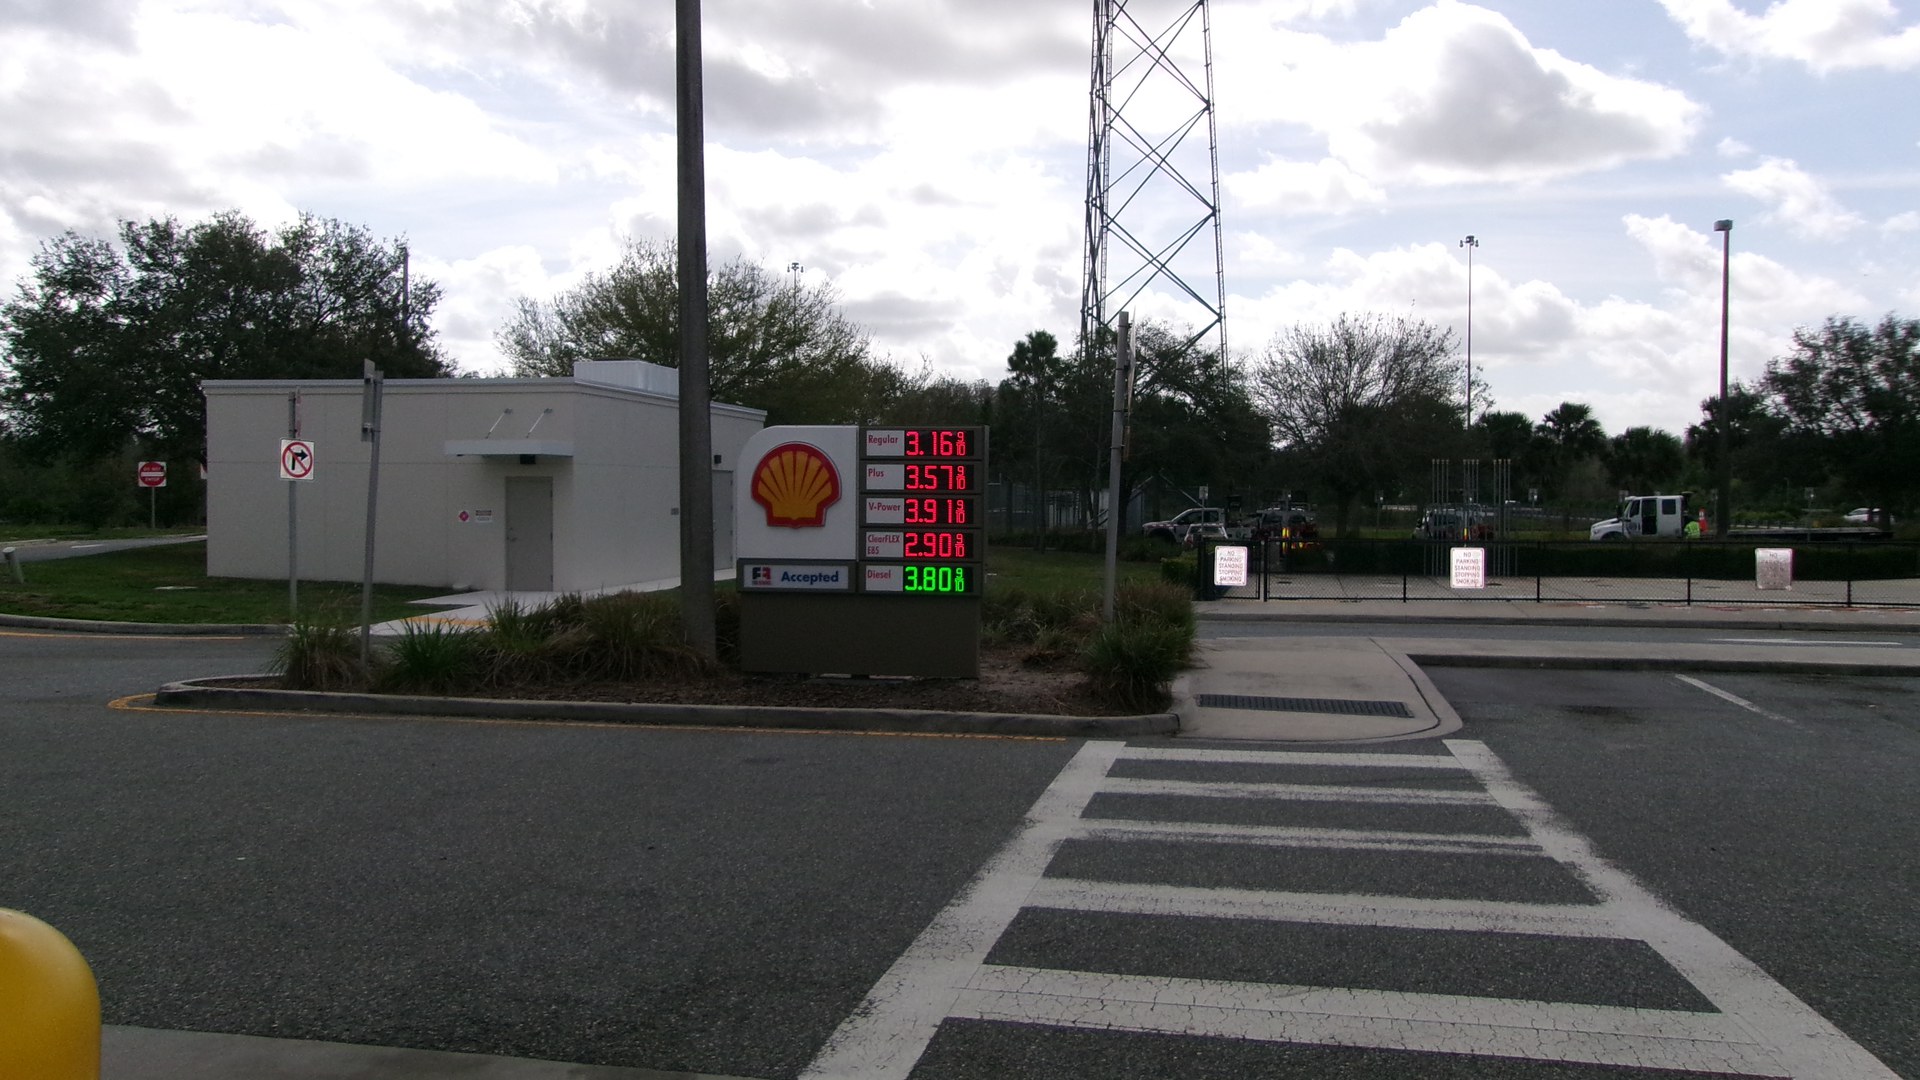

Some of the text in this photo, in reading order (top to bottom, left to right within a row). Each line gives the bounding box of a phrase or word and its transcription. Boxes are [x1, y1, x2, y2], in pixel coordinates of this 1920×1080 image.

[868, 434, 899, 446] Regular
[906, 431, 953, 456] 3.16
[868, 468, 885, 478] Plus
[906, 465, 954, 490] 3.57
[868, 502, 901, 511] V-Power
[906, 499, 953, 523] 3.91
[867, 534, 900, 543] ClearFLEX
[905, 533, 952, 557] 2.90
[781, 570, 839, 586] Accepted
[867, 569, 892, 579] Diesel
[905, 566, 952, 591] 3.80
